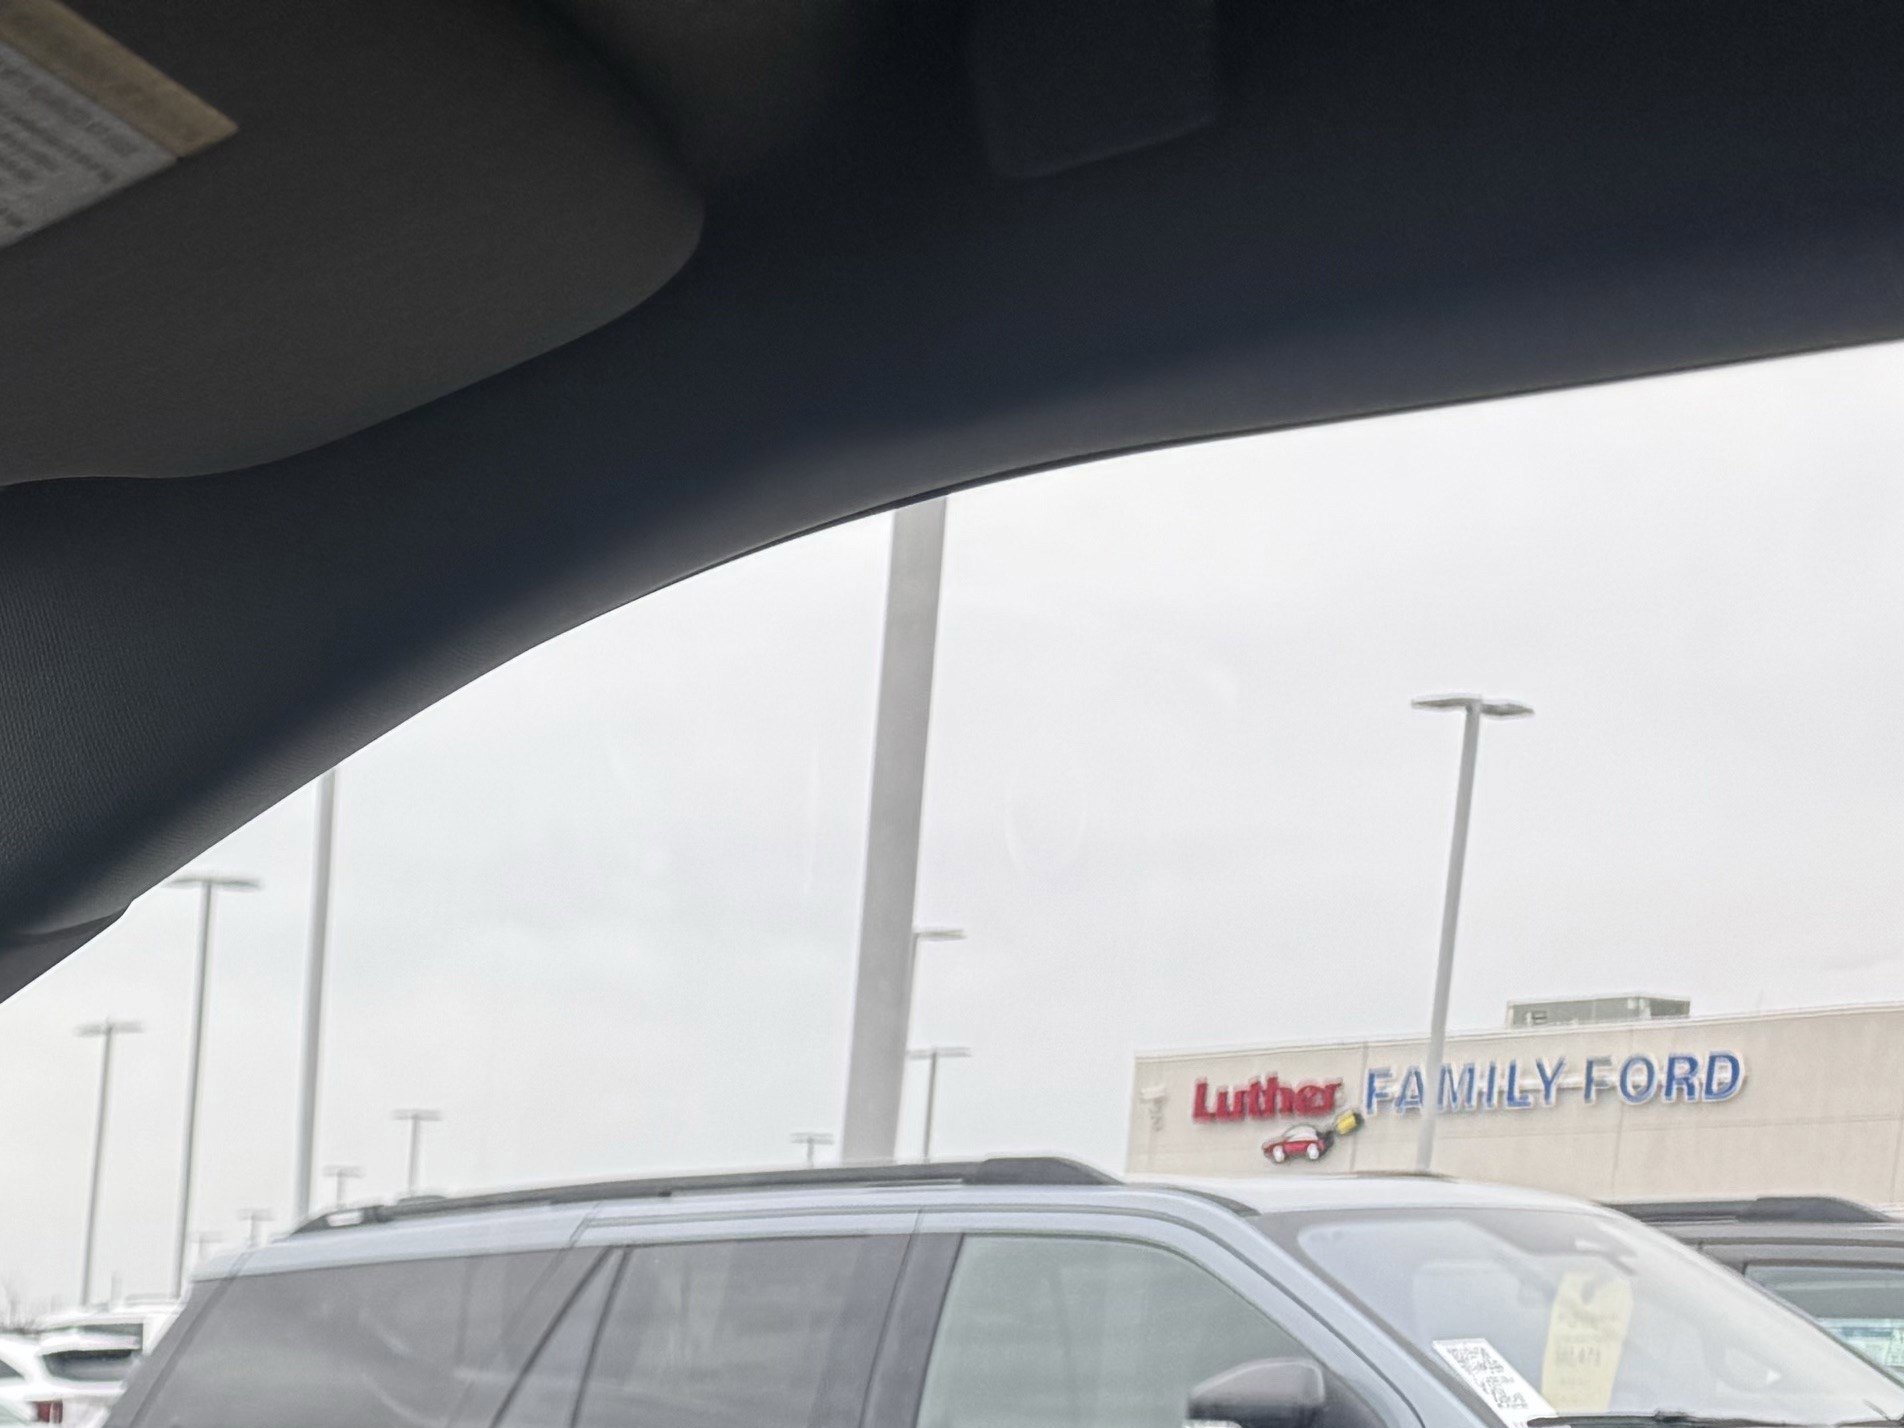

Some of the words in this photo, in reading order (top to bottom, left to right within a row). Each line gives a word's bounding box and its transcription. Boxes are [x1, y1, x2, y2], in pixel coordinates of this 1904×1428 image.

[1192, 1071, 1344, 1124] Luther
[1365, 1055, 1568, 1117] FAMILY
[1584, 1050, 1745, 1106] FORD
